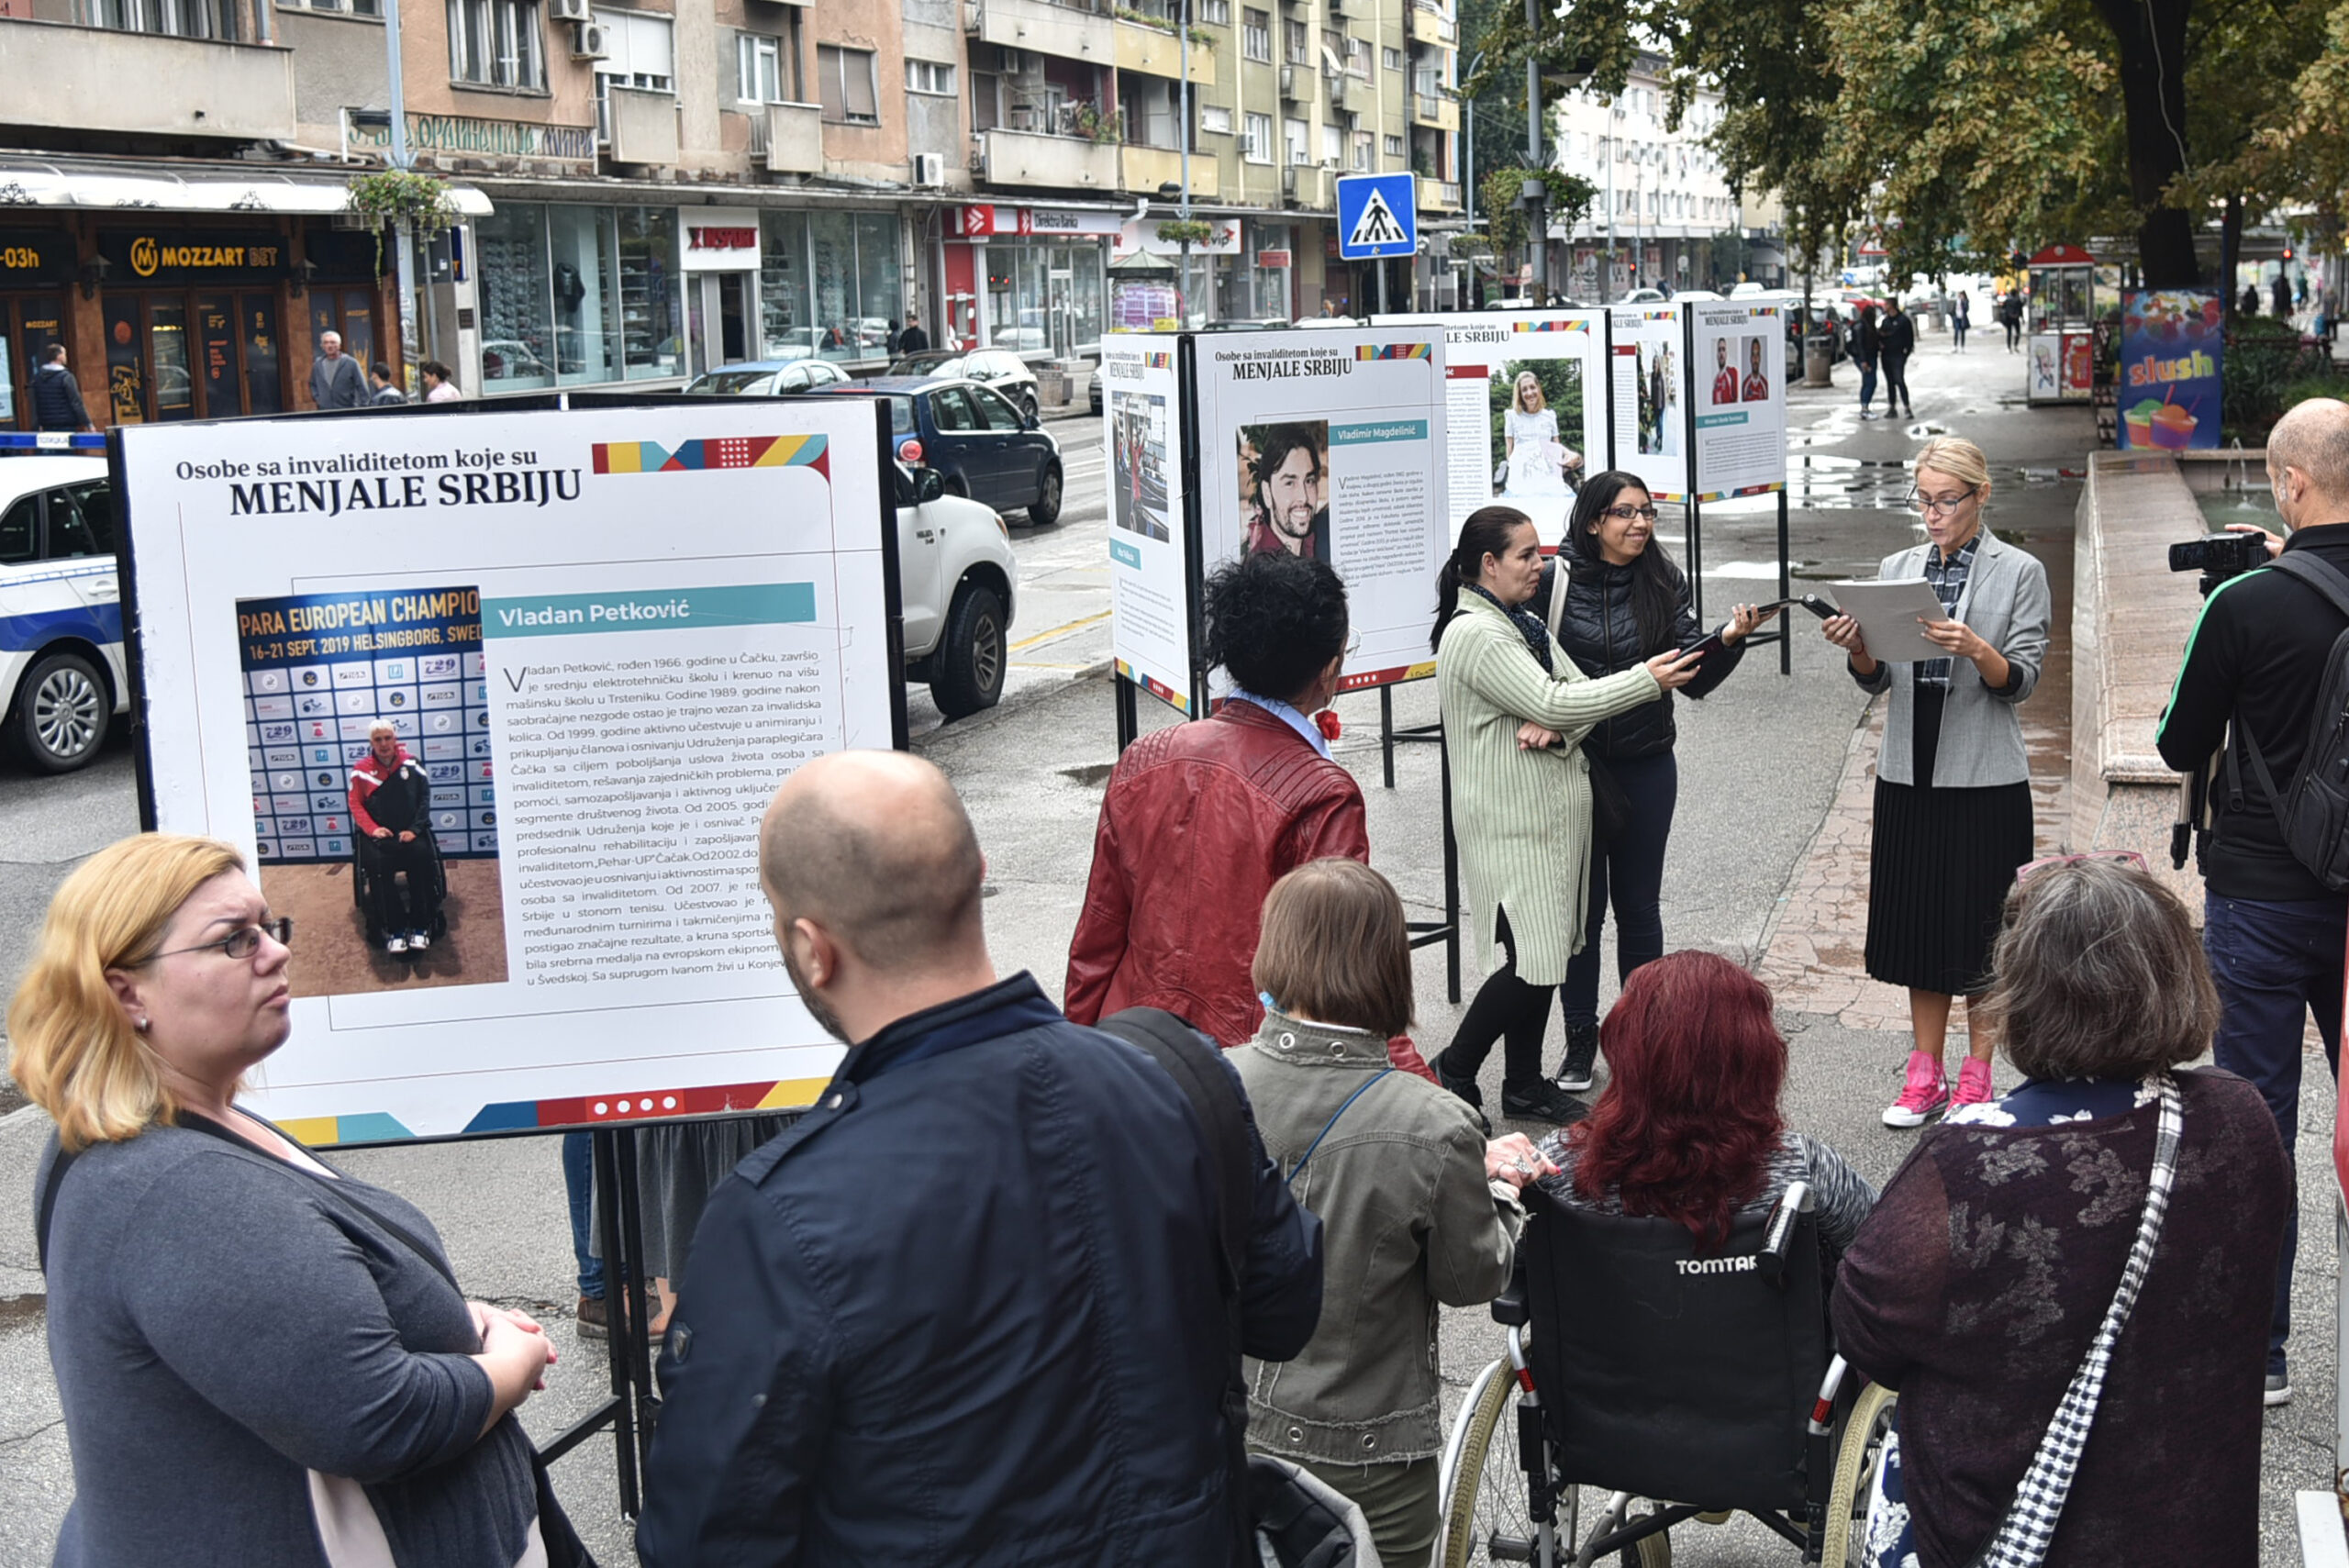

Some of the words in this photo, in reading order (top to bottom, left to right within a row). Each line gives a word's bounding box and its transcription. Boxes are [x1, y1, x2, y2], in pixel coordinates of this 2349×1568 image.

[161, 247, 245, 267] MOZZART
[249, 247, 277, 267] BET
[1464, 330, 1509, 343] SRBIJU
[1215, 350, 1241, 361] Osobe
[1243, 351, 1252, 360] sa
[1254, 348, 1308, 360] invaliditetom
[1310, 347, 1328, 359] koje
[1329, 348, 1338, 356] su
[1233, 361, 1300, 381] MENJALE
[1304, 358, 1353, 377] SRBIJU
[2128, 350, 2214, 386] slush
[1338, 428, 1372, 440] Vladimir
[1373, 425, 1417, 439] Magdelinić
[176, 459, 250, 480] Osobe
[256, 462, 283, 476] sa
[288, 452, 449, 475] invaliditetom
[455, 448, 506, 471] koje
[511, 450, 538, 466] su
[229, 476, 427, 517] MENJALE
[438, 469, 582, 507] SRBIJU
[239, 610, 286, 637] PARA
[289, 598, 387, 633] EUROPEAN
[392, 590, 479, 623] CHAMPIO
[499, 606, 584, 628] Vladan
[590, 598, 690, 622] Petković
[250, 642, 284, 660] 16-21
[321, 635, 350, 654] 2019
[352, 628, 444, 651] HELSINGBORG,
[617, 660, 651, 671] rođen
[685, 656, 727, 669] godine
[780, 651, 818, 662] završio
[529, 683, 539, 694] je
[543, 680, 588, 692] srednju
[592, 673, 684, 688] elektrotehničku
[688, 672, 719, 683] školu
[732, 671, 774, 681] krenuo
[777, 670, 793, 678] na
[797, 666, 819, 677] višu
[506, 697, 562, 709] mašinsku
[564, 695, 595, 706] školu
[664, 689, 707, 700] Godine
[741, 685, 783, 699] godine
[785, 684, 820, 694] nakon
[579, 710, 630, 723] nezgode
[632, 709, 664, 718] ostao
[666, 707, 677, 719] je
[679, 706, 714, 717] trajno
[715, 705, 749, 714] vezan
[751, 704, 764, 712] za
[766, 699, 821, 711] invalidska
[547, 729, 565, 740] Od
[600, 726, 641, 740] godine
[643, 724, 686, 735] aktivno
[688, 721, 742, 732] učestvuje
[755, 716, 817, 728] animiranju
[510, 747, 580, 761] prikupljanju
[580, 744, 625, 754] članova
[630, 741, 685, 751] osnivanju
[686, 736, 746, 749] Udruženja
[747, 732, 824, 747] paraplegičara
[510, 763, 547, 774] Čačka
[553, 764, 566, 773] sa
[573, 761, 609, 773] ciljem
[616, 755, 682, 771] poboljšanja
[688, 753, 724, 764] uslova
[730, 751, 764, 762] života
[771, 749, 806, 760] osoba
[593, 774, 646, 786] rešavanja
[648, 770, 714, 784] zajedničkih
[564, 789, 672, 805] samozapošljavanja
[682, 786, 732, 797] aktivnog
[514, 813, 573, 826] segmente
[576, 808, 641, 820] društvenog
[684, 803, 703, 813] Od
[516, 827, 582, 842] predsednik
[586, 823, 646, 837] Udruženja
[651, 821, 675, 833] koje
[680, 821, 690, 832] je
[703, 816, 745, 828] osnivač
[517, 843, 596, 859] profesionalnu
[603, 837, 677, 851] rehabilitaciju
[518, 861, 594, 873] invaliditetom
[519, 877, 584, 889] učestvovao
[603, 873, 657, 884] osnivanju
[662, 867, 735, 879] aktivnostima
[520, 895, 556, 905] osoba
[665, 884, 684, 895] Od
[729, 884, 739, 894] je
[522, 911, 555, 922] Srbije
[577, 906, 622, 917] stonom
[674, 899, 738, 911] Učestvovao
[744, 897, 755, 908] je
[523, 923, 616, 937] međunarodnim
[618, 919, 673, 930] turnirima
[682, 914, 761, 927] takmičenjima
[524, 942, 574, 956] postigao
[577, 938, 629, 951] značajne
[696, 931, 729, 941] kruna
[526, 960, 548, 969] bila
[549, 957, 594, 968] srebrna
[596, 952, 643, 964] medalja
[645, 952, 661, 961] na
[662, 947, 726, 960] evropskom
[592, 971, 607, 981] Sa
[608, 968, 669, 981] suprugom
[671, 964, 714, 975] Ivanom
[717, 962, 735, 972] živi
